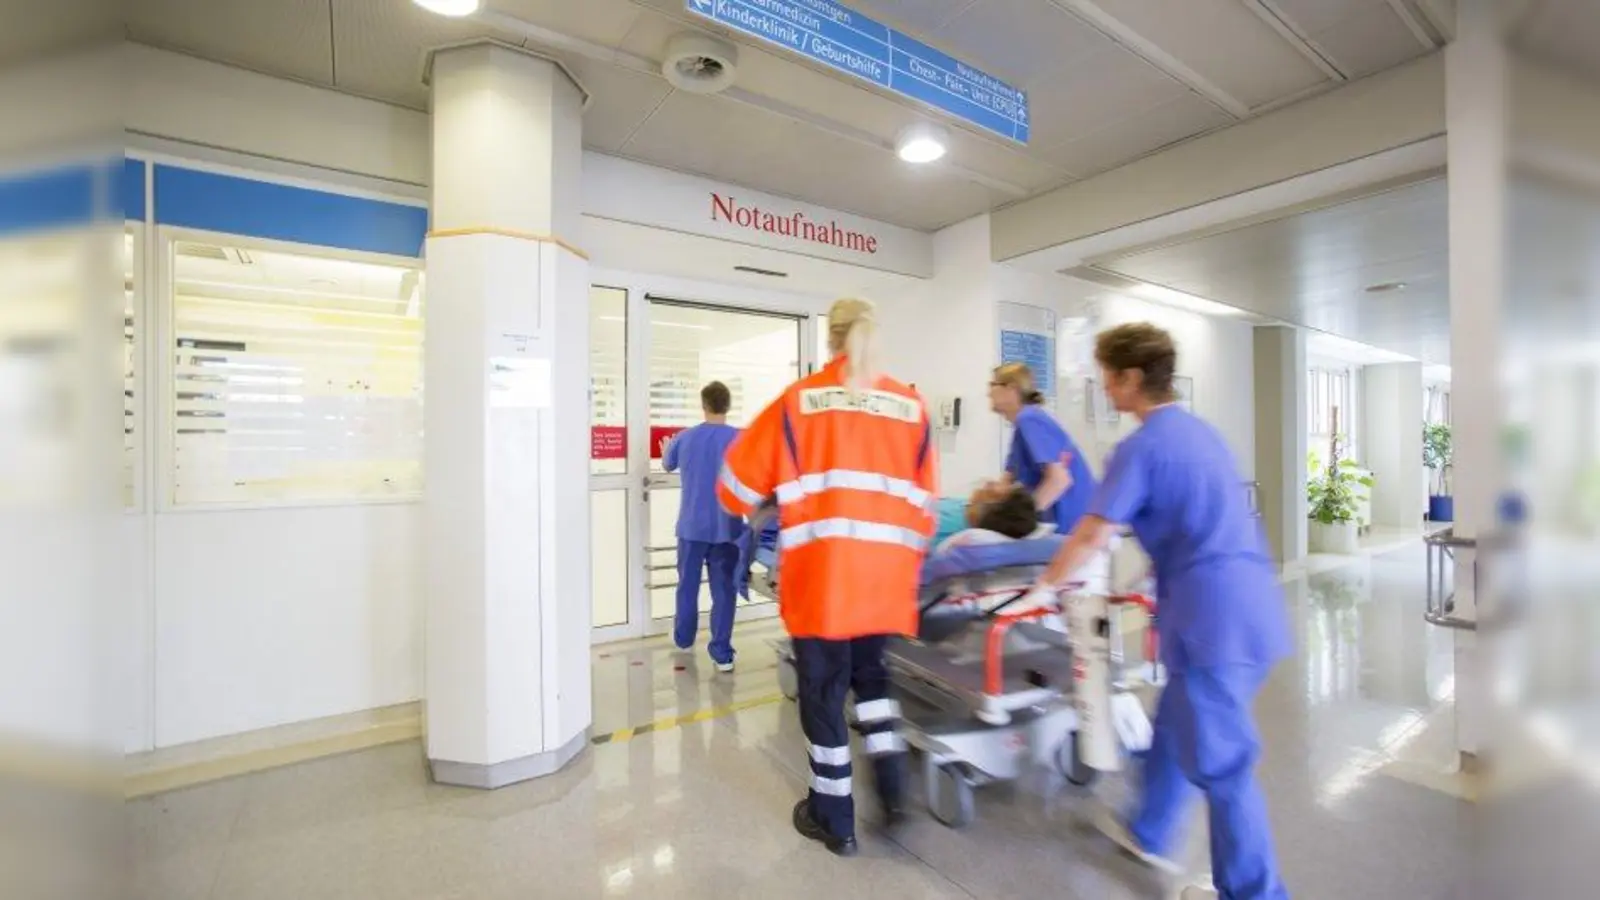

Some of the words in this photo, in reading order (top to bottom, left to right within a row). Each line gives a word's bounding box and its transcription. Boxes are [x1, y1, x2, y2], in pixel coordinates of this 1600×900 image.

[716, 0, 799, 46] Kinderklinik
[811, 37, 881, 79] Geburtshilfe
[803, 0, 852, 25] ntgen
[709, 191, 878, 254] Notaufnahme
